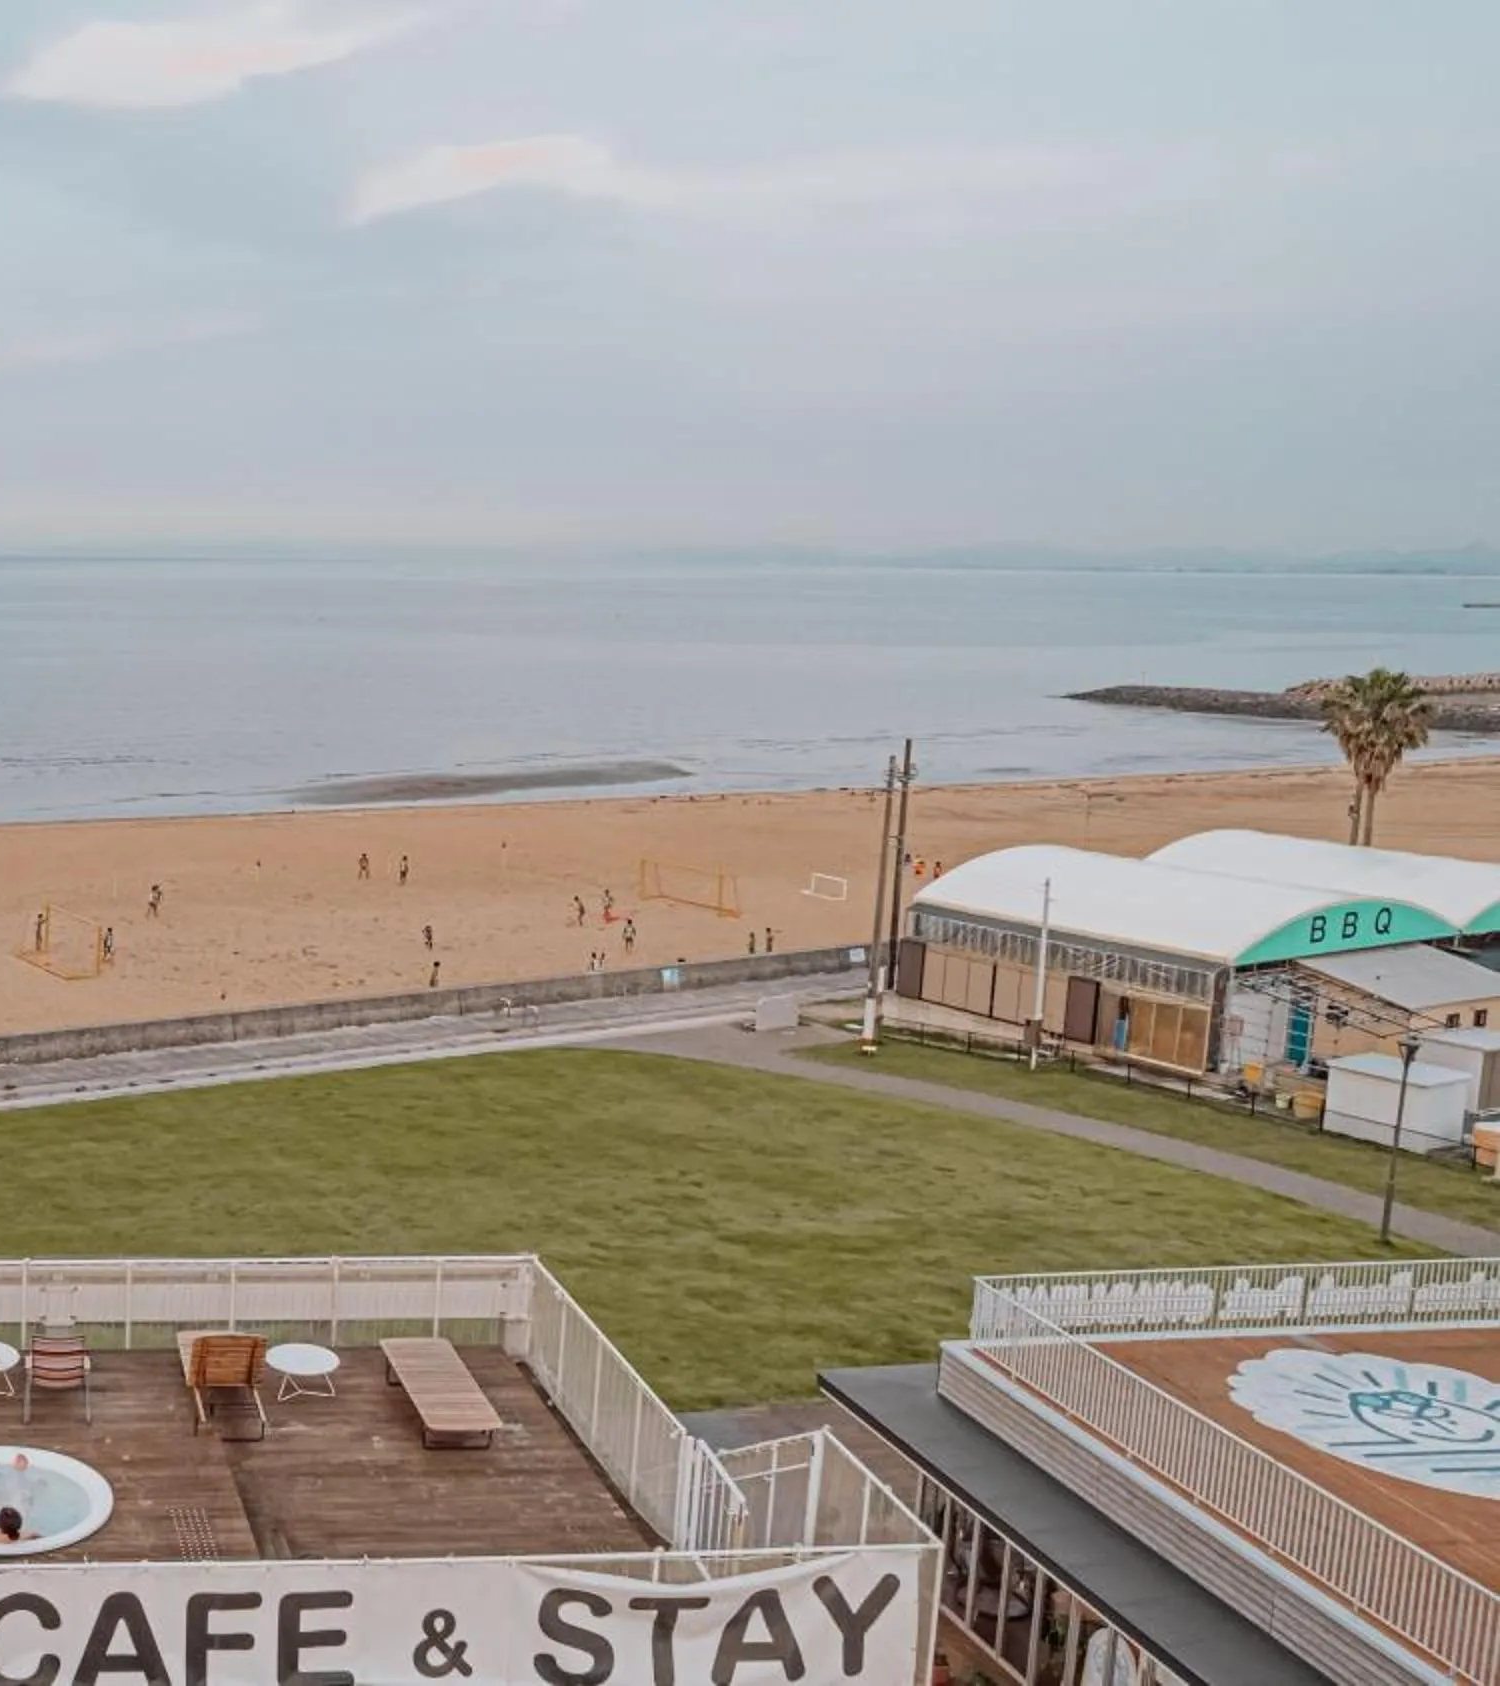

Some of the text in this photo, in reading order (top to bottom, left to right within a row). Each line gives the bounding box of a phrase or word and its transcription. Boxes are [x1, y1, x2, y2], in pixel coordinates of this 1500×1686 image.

[1309, 907, 1393, 944] BBQ
[412, 1608, 474, 1678] &
[533, 1573, 902, 1686] STAY
